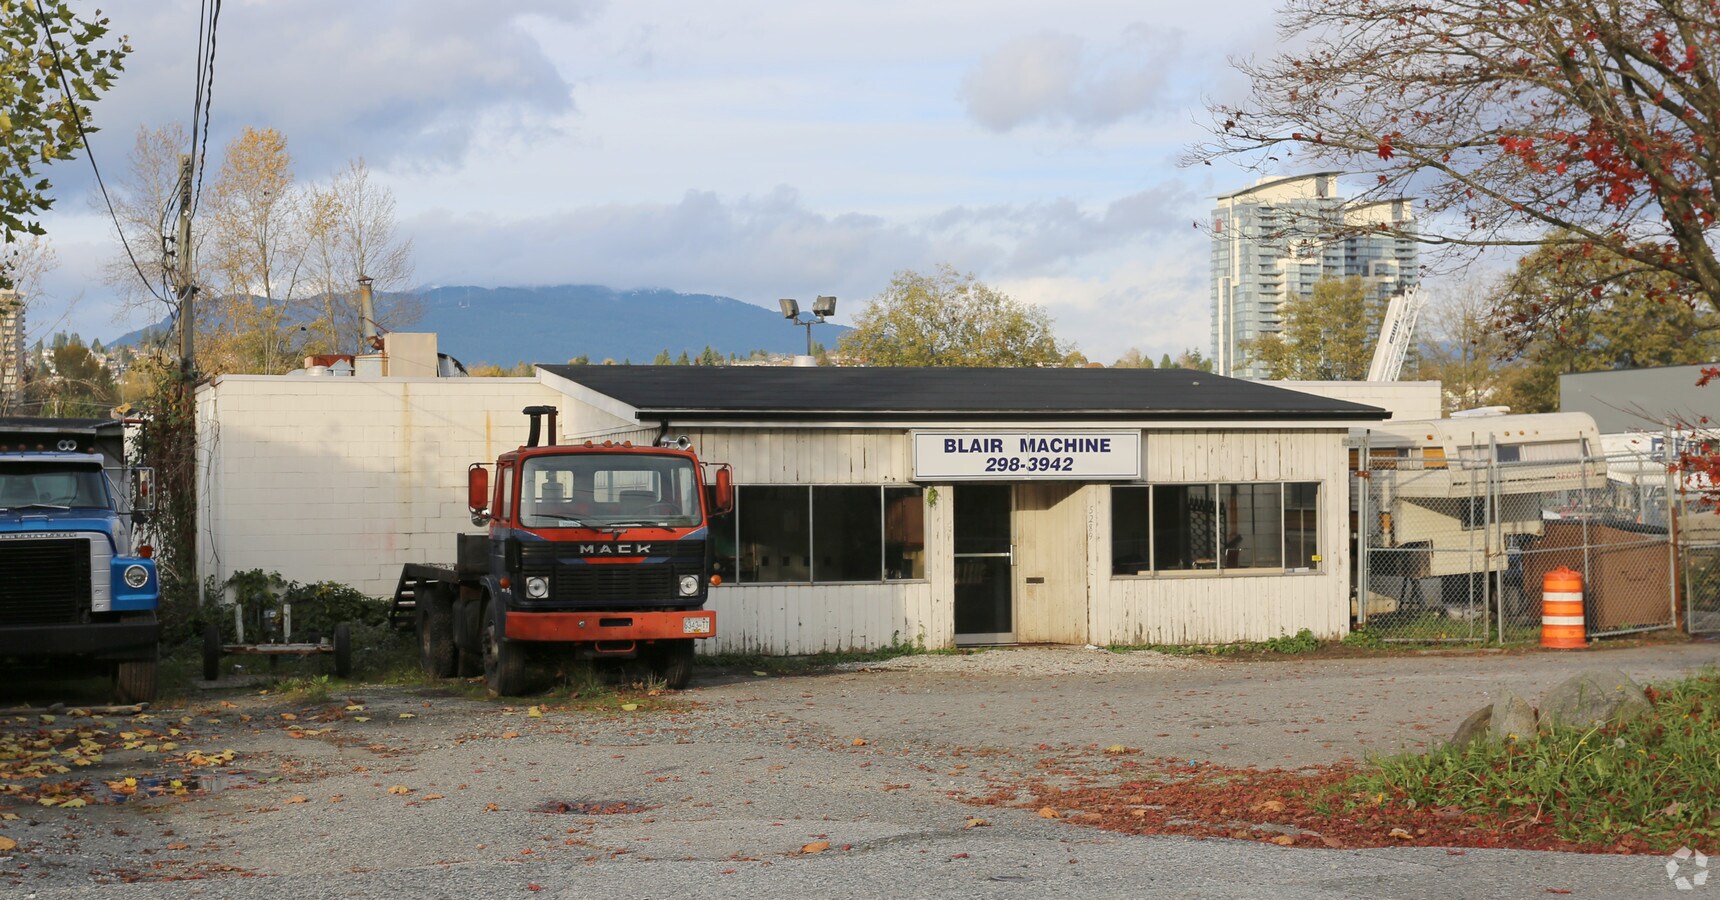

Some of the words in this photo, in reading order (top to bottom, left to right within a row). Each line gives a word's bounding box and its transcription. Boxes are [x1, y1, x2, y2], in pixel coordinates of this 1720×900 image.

[944, 438, 1004, 453] BLAIR
[1019, 438, 1111, 453] MACHINE
[985, 457, 1074, 472] 298-3942
[1556, 469, 1596, 481] SECURTY
[580, 544, 651, 554] MACK
